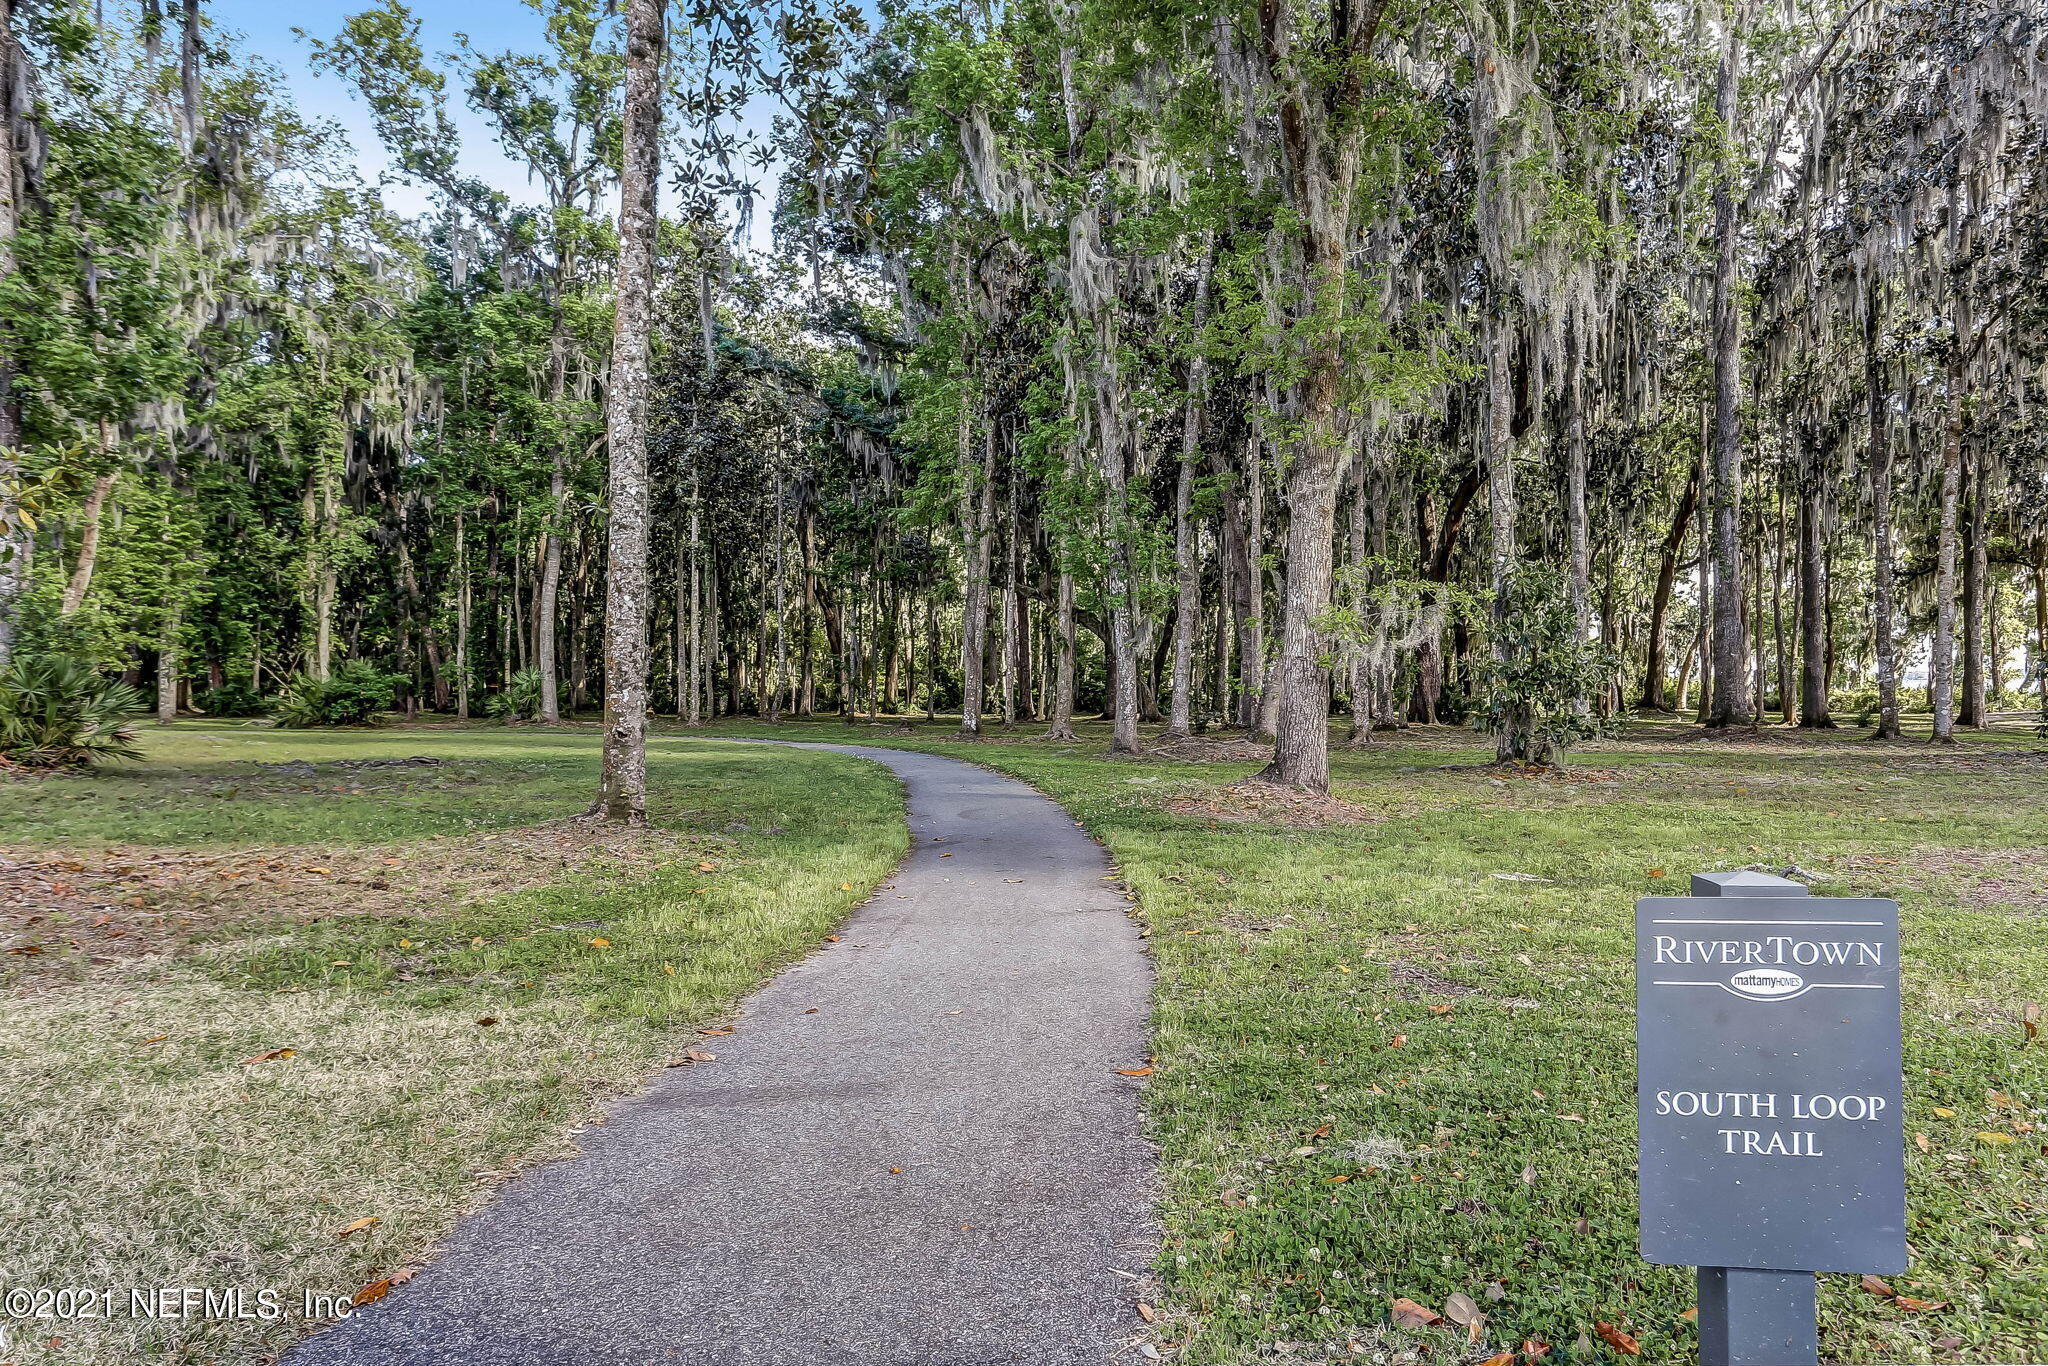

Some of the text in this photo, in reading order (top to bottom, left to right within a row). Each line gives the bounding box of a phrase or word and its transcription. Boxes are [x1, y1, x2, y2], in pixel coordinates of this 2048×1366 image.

[1656, 1090, 1886, 1121] SOUTH LOOP
[1718, 1129, 1824, 1157] TRAIL
